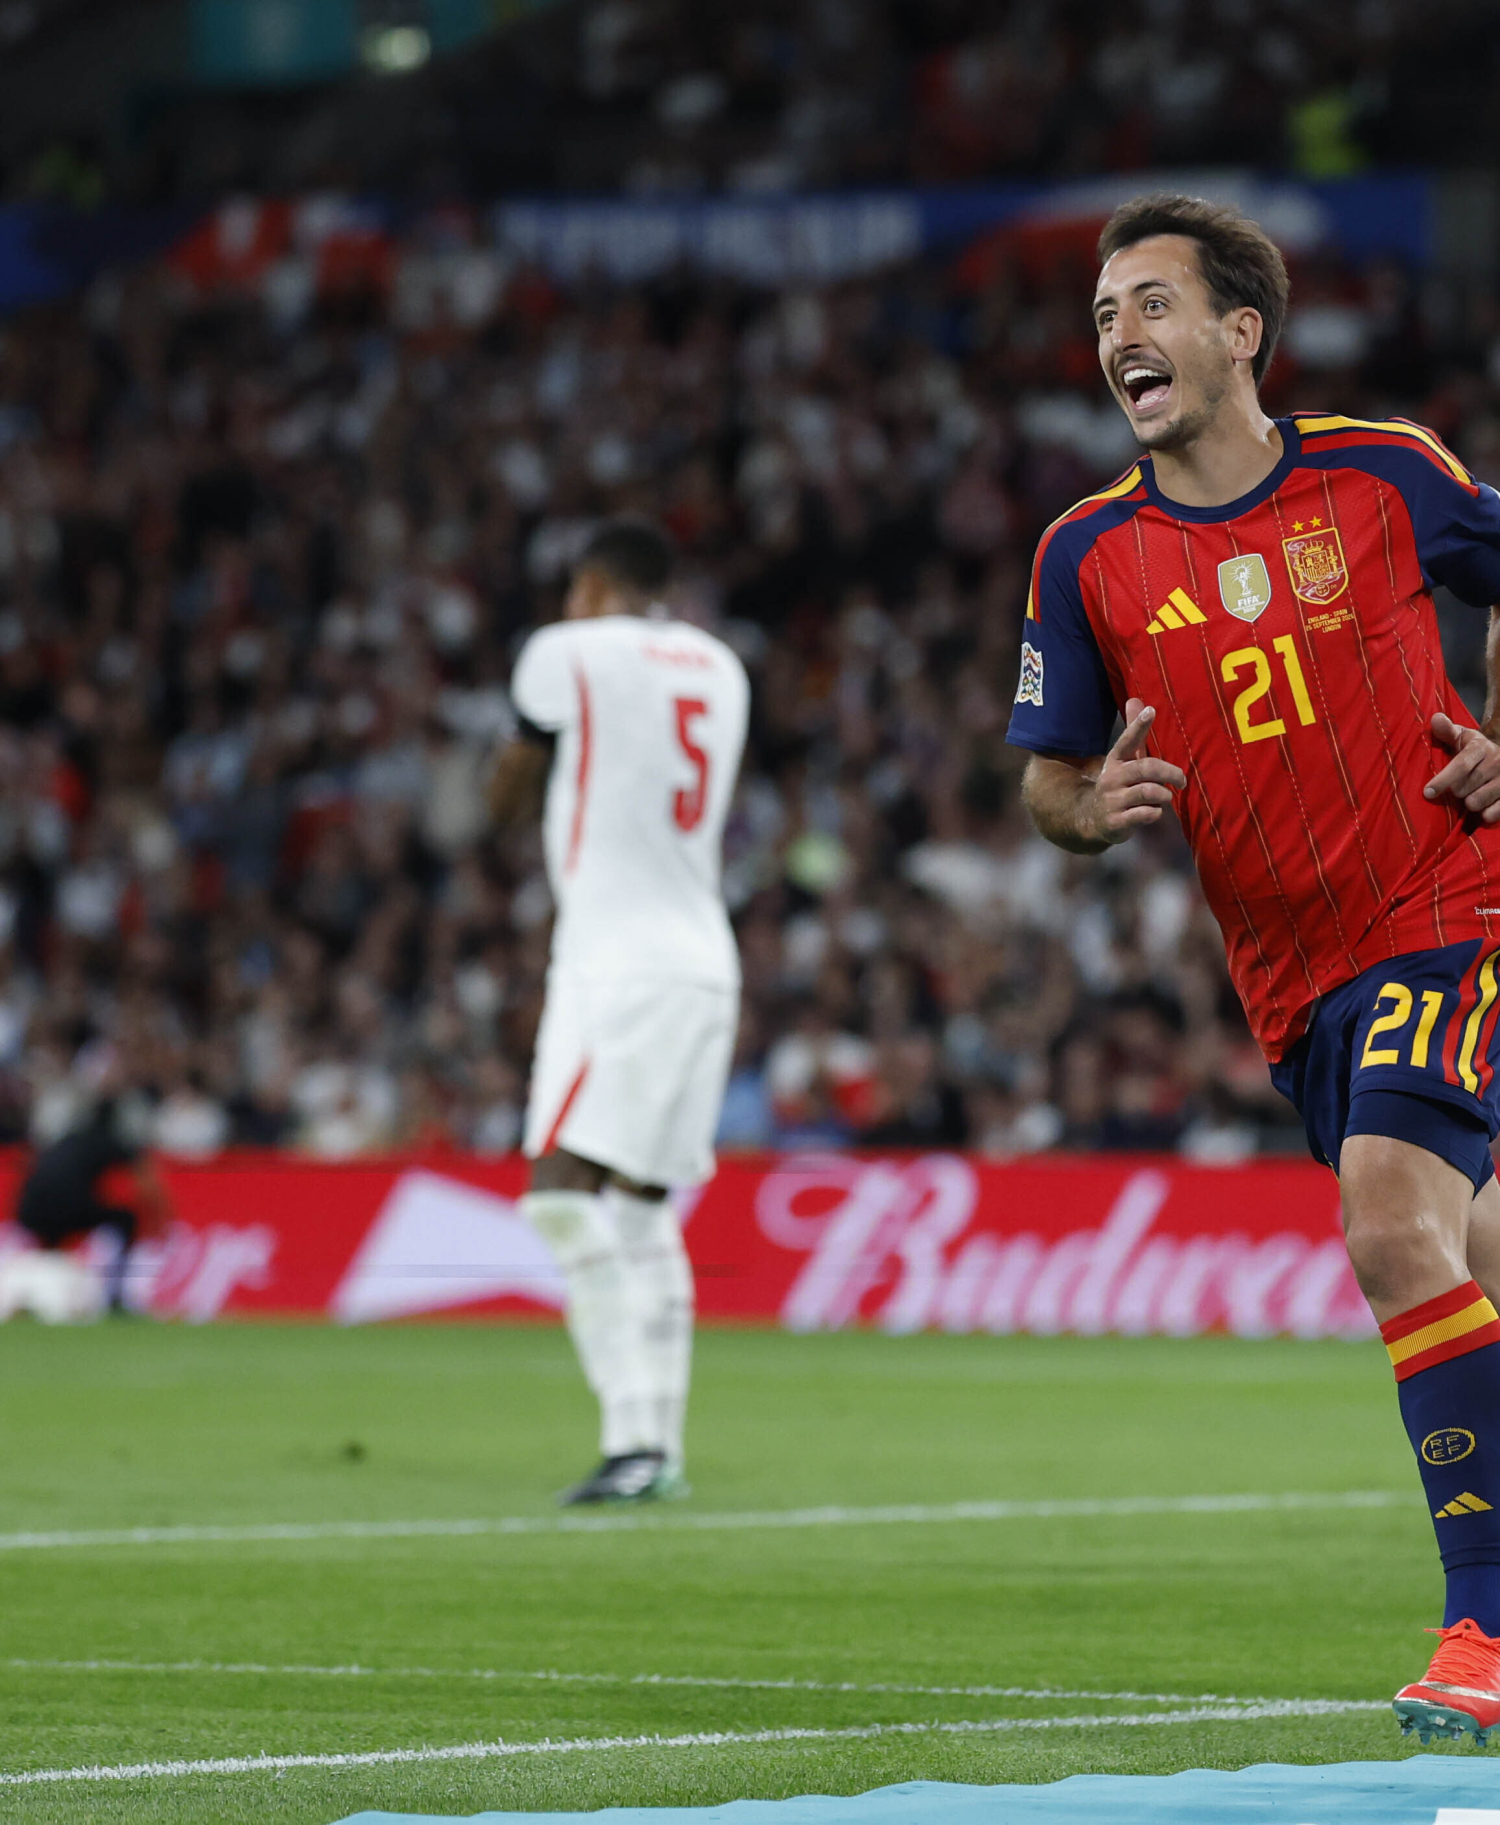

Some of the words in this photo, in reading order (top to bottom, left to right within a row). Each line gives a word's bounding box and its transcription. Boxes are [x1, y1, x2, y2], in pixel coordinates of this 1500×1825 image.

[1237, 595, 1260, 607] FIFA
[1307, 613, 1329, 624] ENGLAND
[1333, 608, 1348, 617] SPAIN
[1313, 616, 1341, 629] SEPTEMBER
[1322, 623, 1342, 633] LONDON
[1220, 633, 1317, 744] 21
[672, 696, 709, 834] 5
[1360, 982, 1444, 1070] 21
